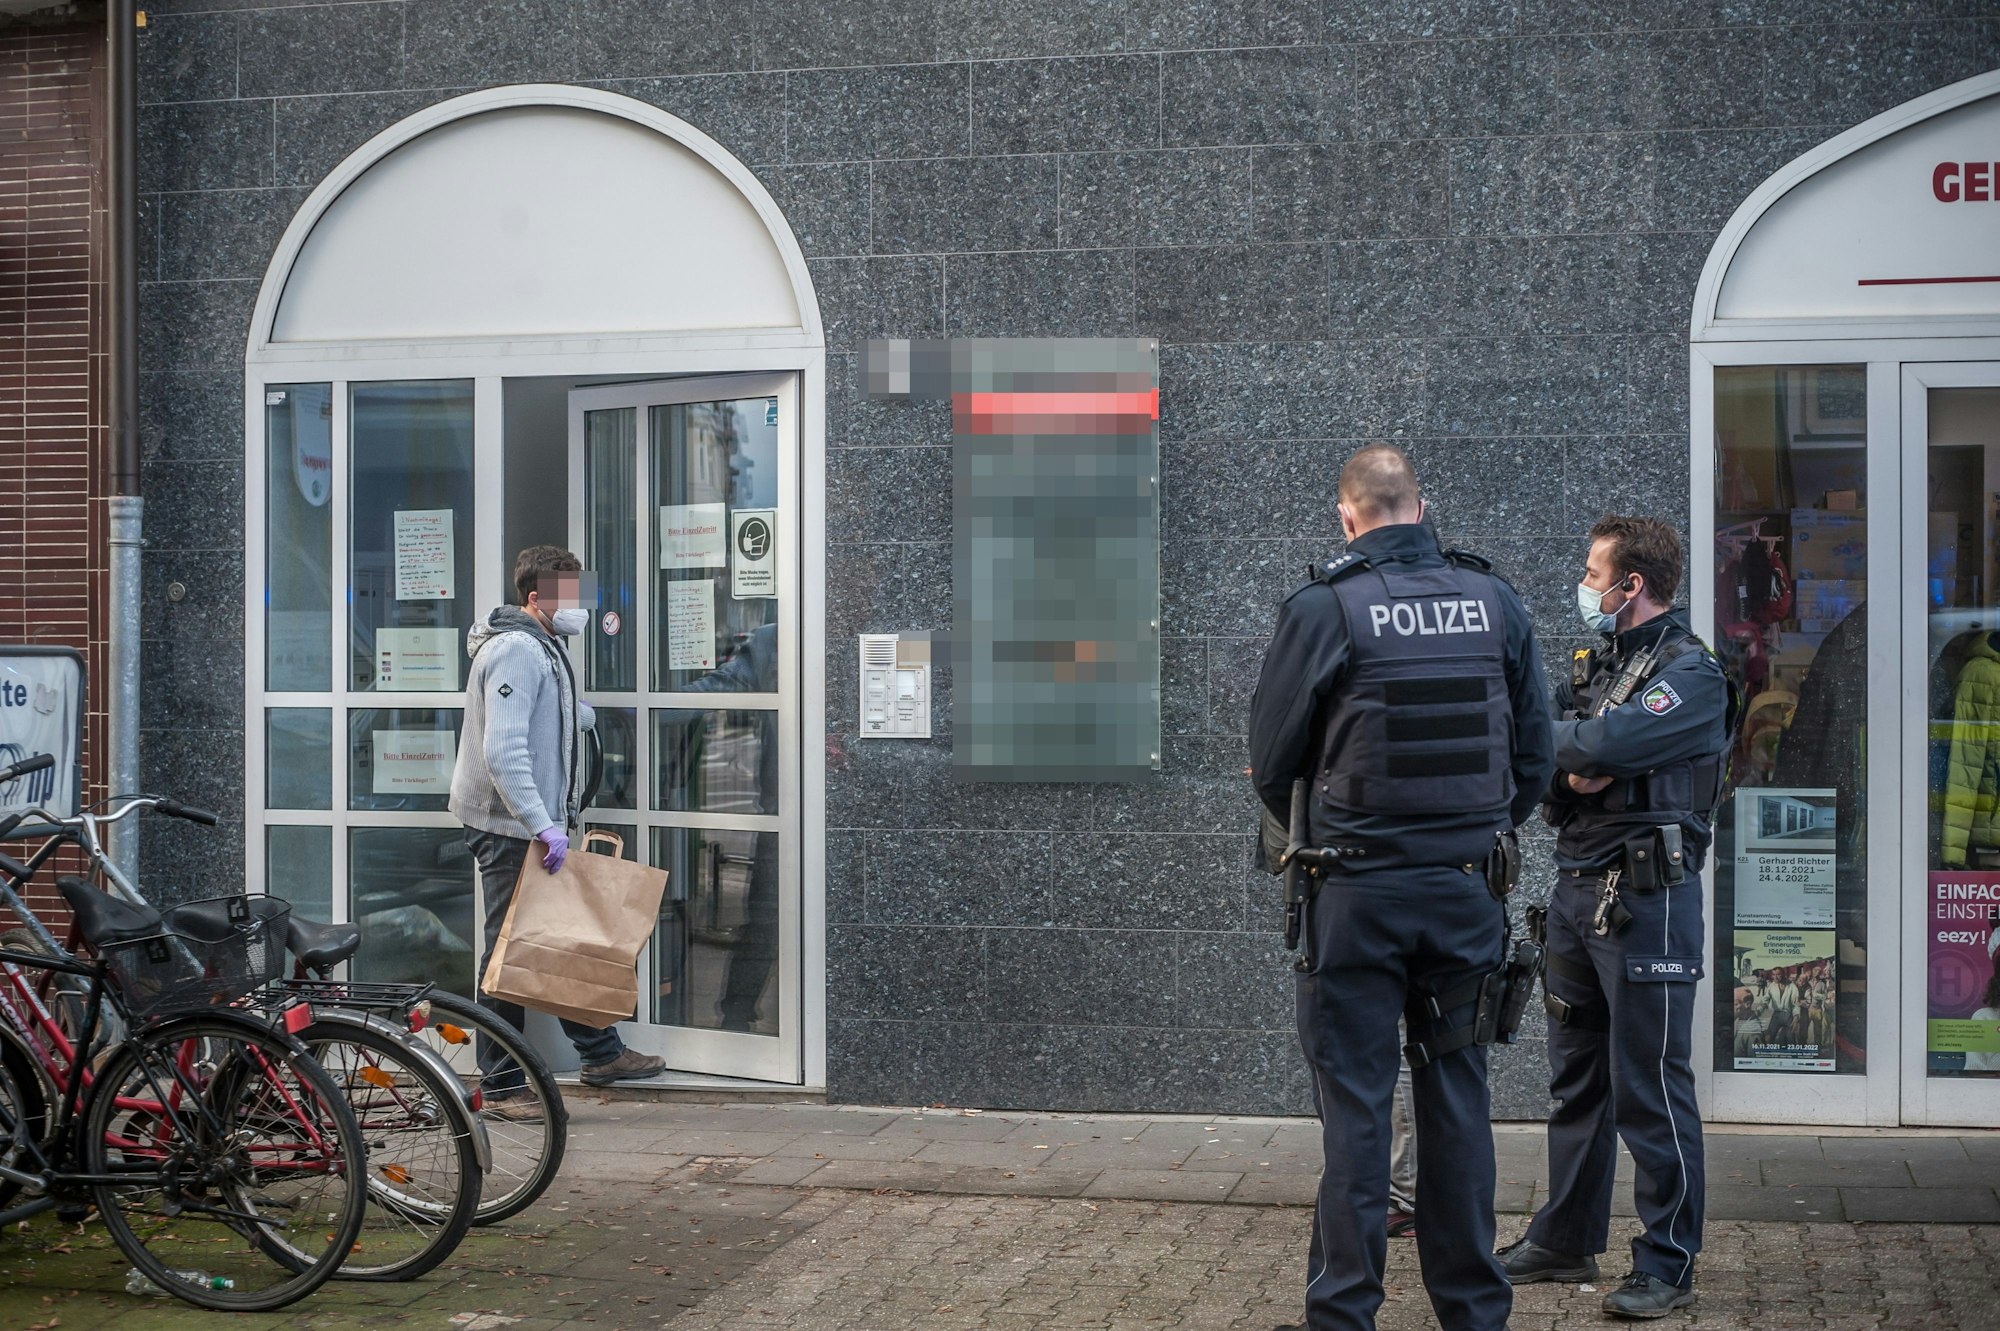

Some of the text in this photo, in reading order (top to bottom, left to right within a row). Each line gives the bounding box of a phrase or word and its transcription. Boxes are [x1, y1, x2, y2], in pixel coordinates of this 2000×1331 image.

[1369, 600, 1490, 637] POLIZEI
[1658, 681, 1681, 706] POLIZEI
[383, 752, 445, 761] Bitte EinzelZutritt
[1758, 857, 1796, 865] Gerhard
[1797, 857, 1831, 866] Richter
[1937, 903, 2000, 920] EINSTE
[1766, 934, 1803, 942] Gespaltene
[1763, 941, 1806, 949] Erinnerungen
[1651, 963, 1683, 973] POLIZEI
